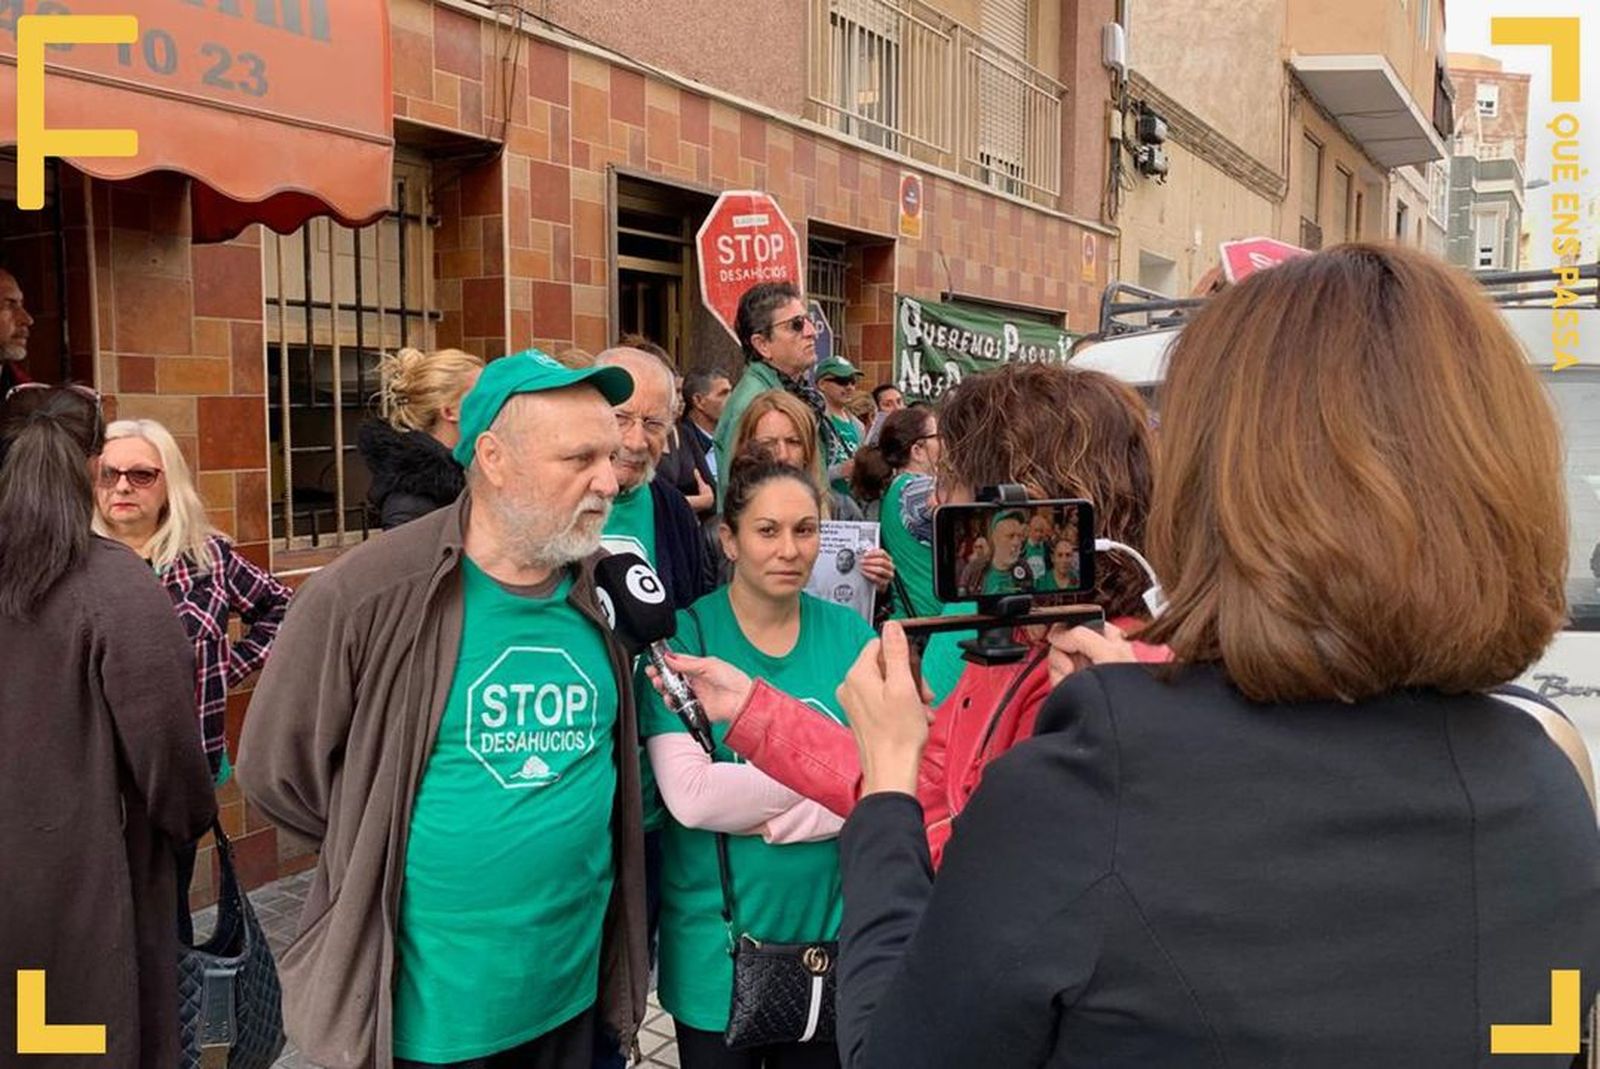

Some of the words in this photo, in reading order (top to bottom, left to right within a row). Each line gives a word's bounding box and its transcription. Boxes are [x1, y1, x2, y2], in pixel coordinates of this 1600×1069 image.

[202, 42, 268, 97] 23
[717, 233, 784, 264] STOP
[481, 683, 588, 728] STOP
[481, 730, 585, 753] DESAHUCIOS
